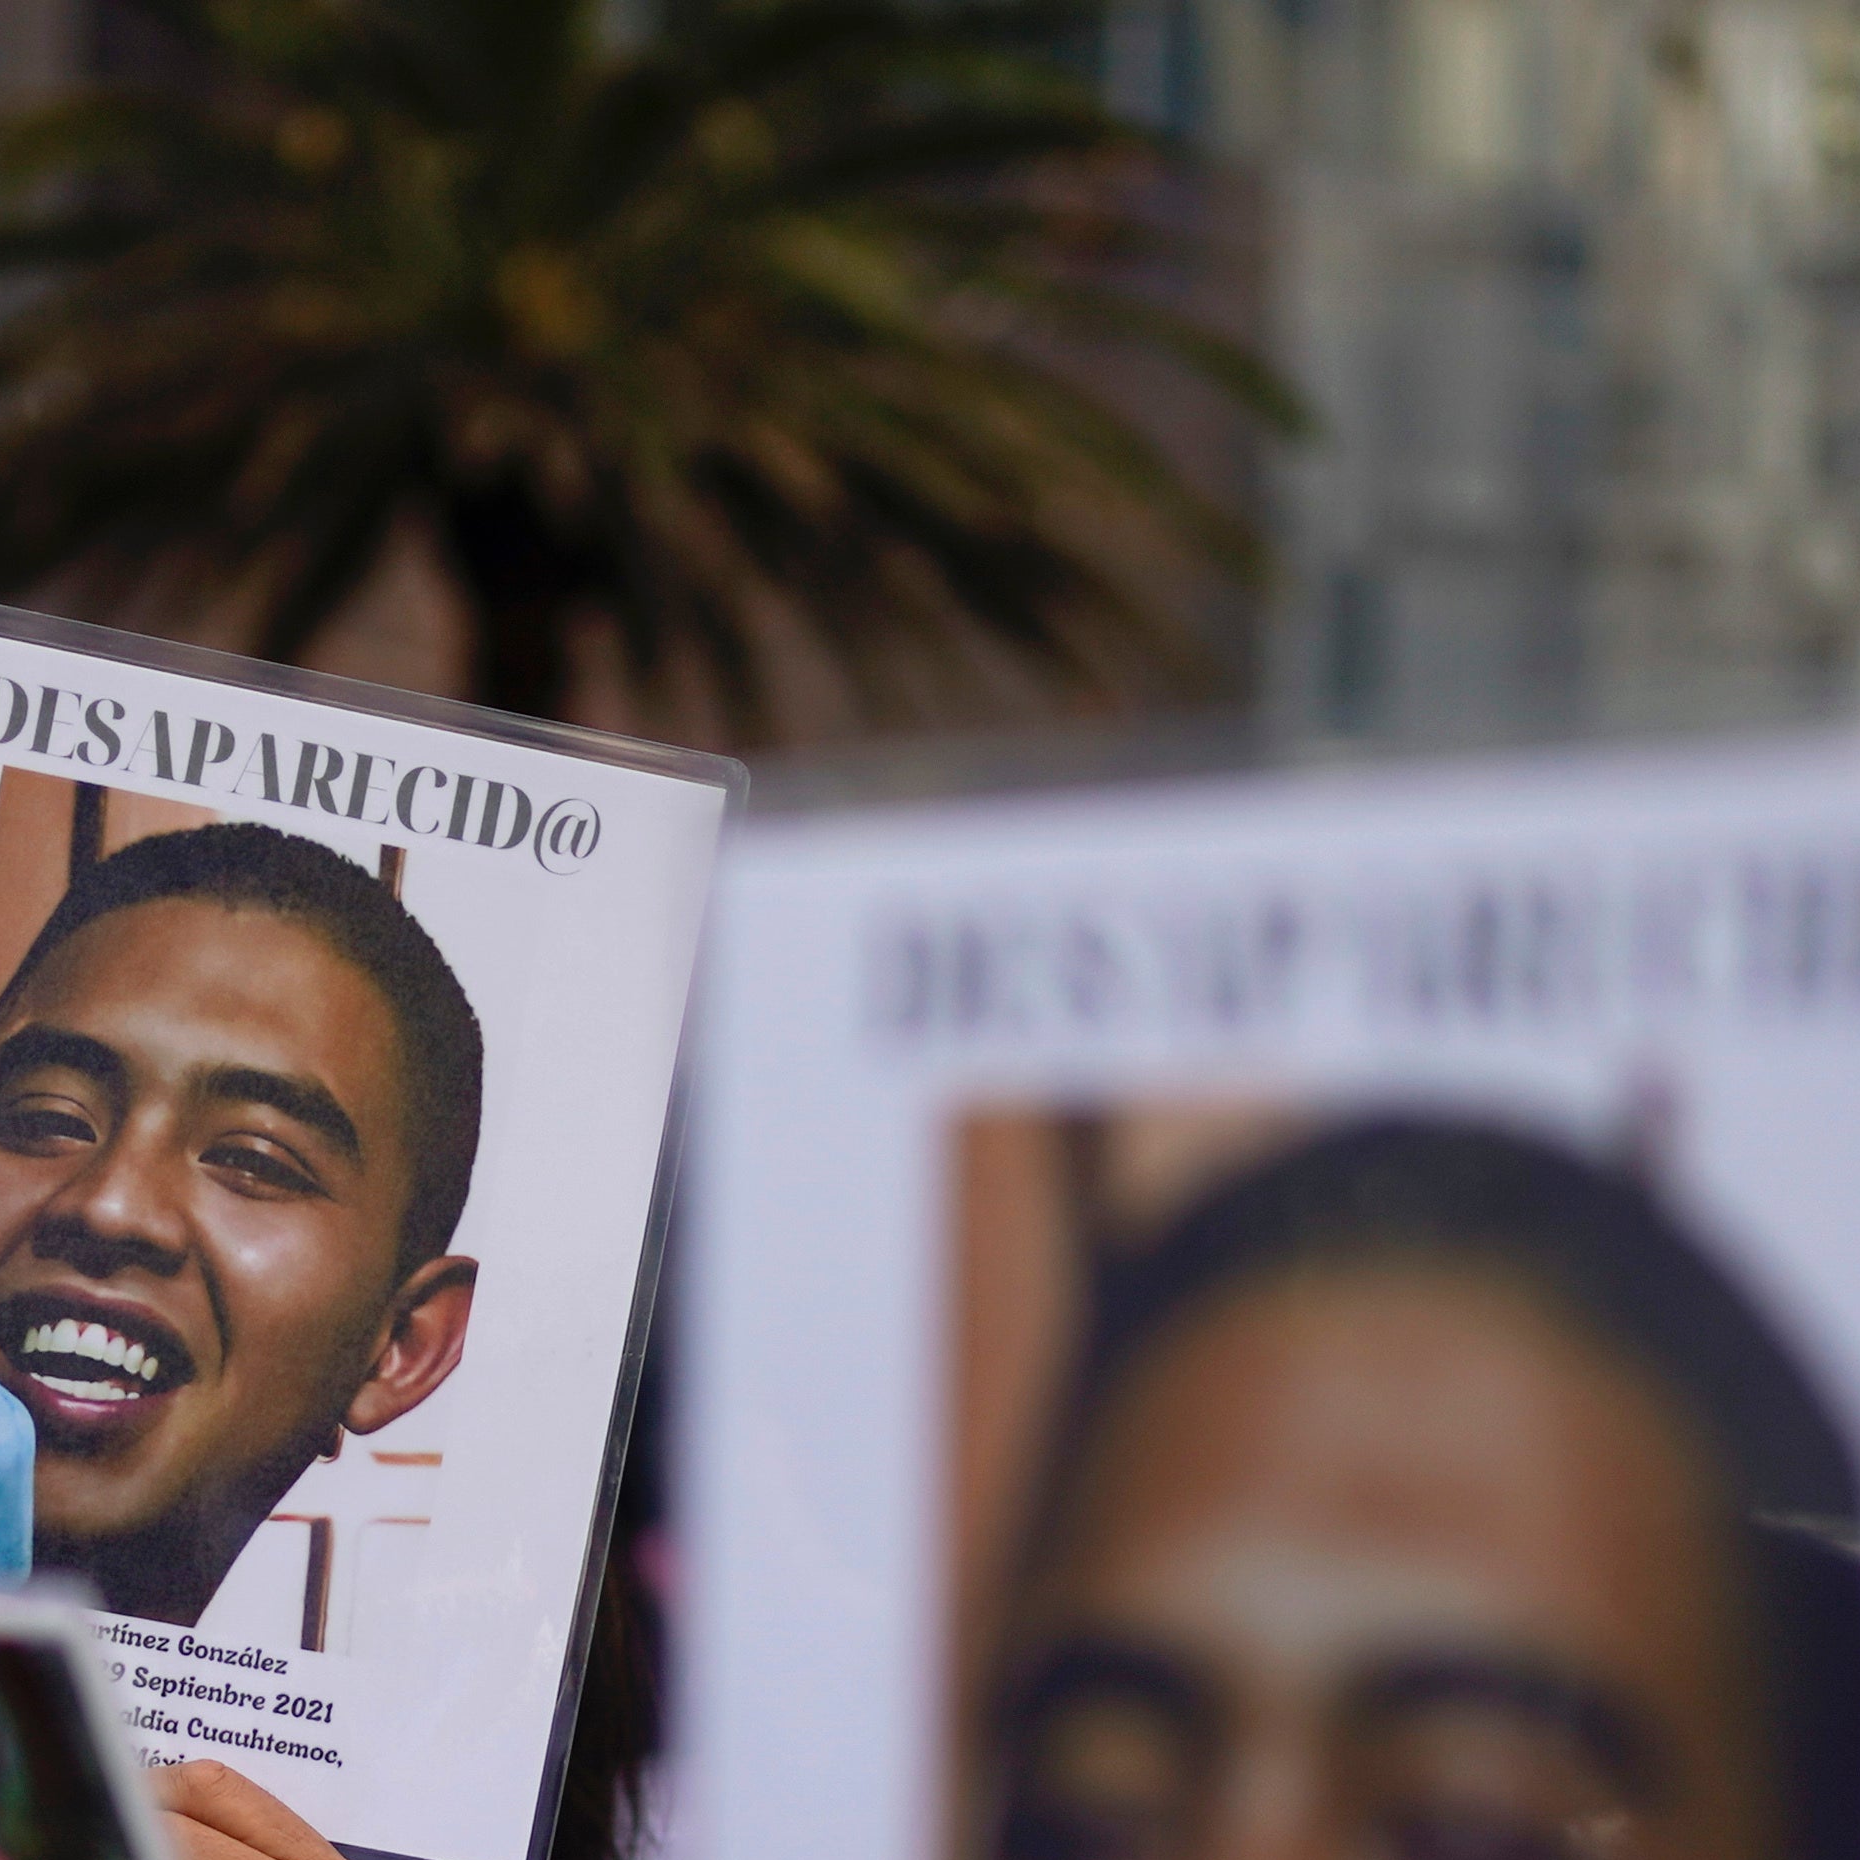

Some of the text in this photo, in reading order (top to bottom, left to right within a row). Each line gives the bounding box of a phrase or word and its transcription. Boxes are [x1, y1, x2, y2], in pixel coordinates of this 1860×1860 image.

[90, 1622, 289, 1676] artínez González
[132, 1666, 267, 1711] Septienbre
[272, 1693, 334, 1724] 2021
[121, 1705, 344, 1768] aldia Cuauhtemoc,
